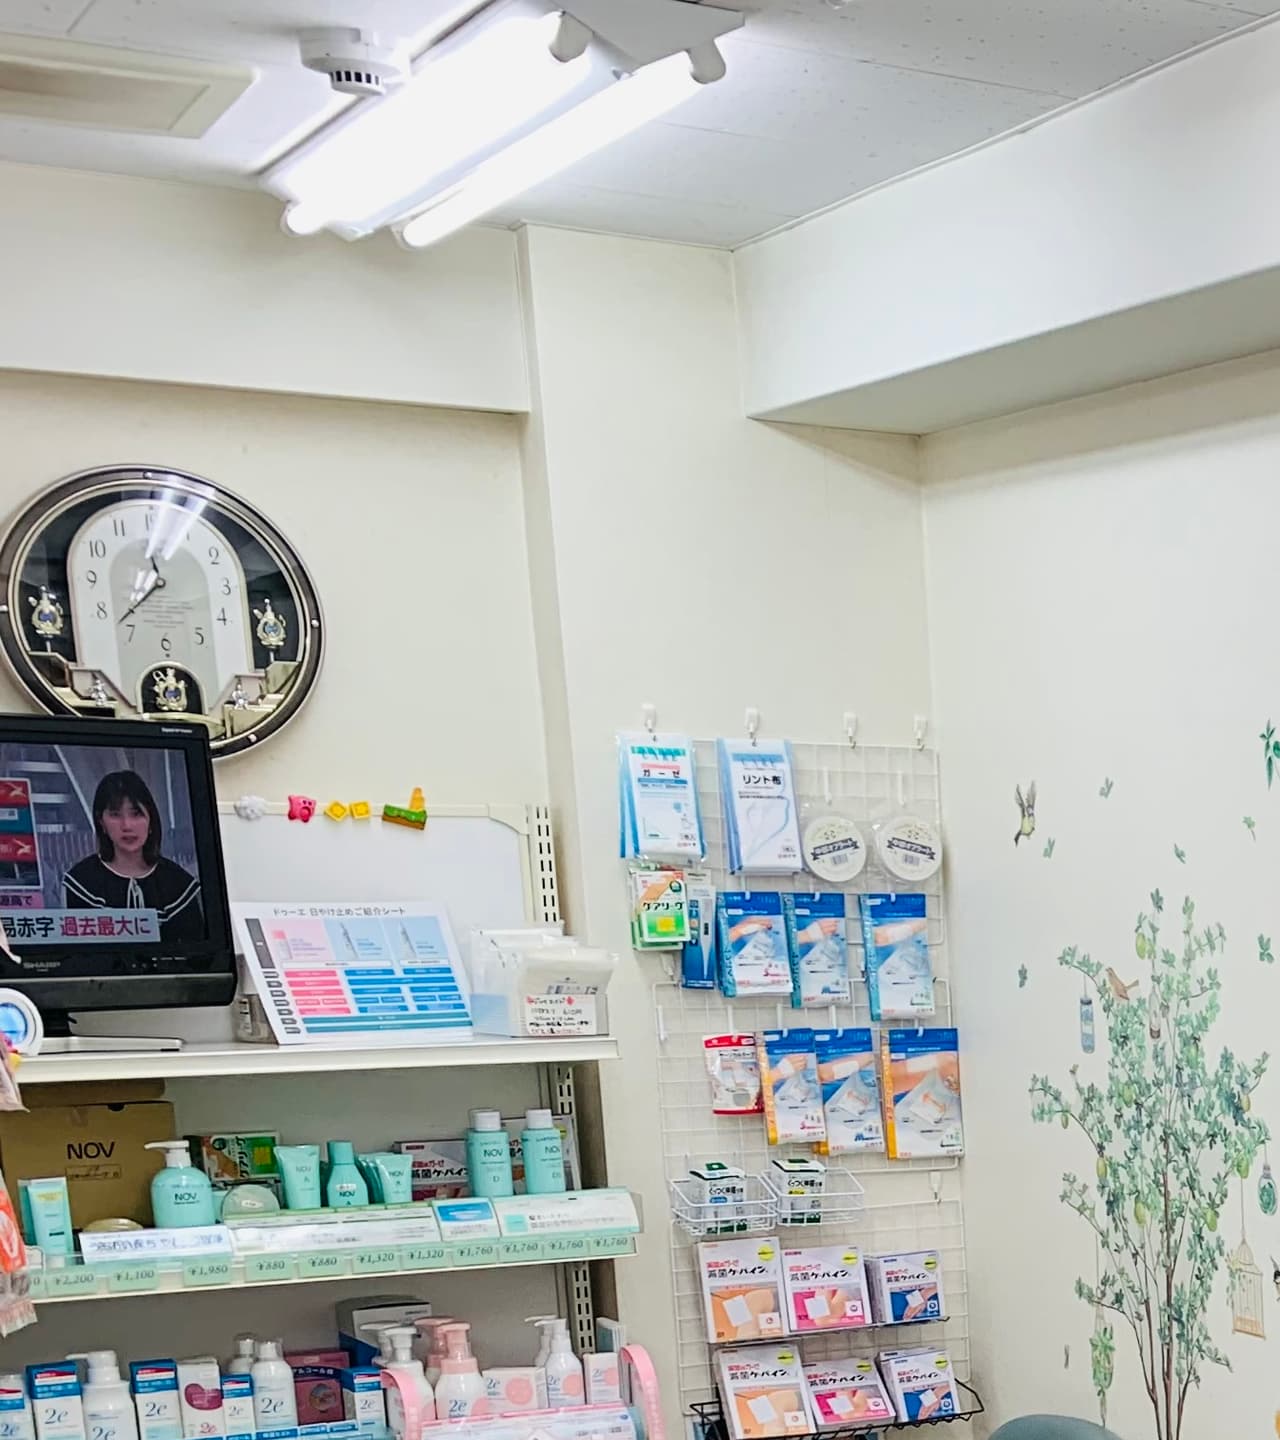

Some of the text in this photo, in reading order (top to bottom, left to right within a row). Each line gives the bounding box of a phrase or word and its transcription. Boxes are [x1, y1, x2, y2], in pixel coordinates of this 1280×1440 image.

[112, 518, 126, 537] 11
[89, 539, 107, 559] 10
[208, 546, 221, 566] 2
[86, 569, 98, 589] 9
[221, 580, 232, 596] 3
[96, 602, 108, 620] 8
[216, 607, 228, 626] 4
[124, 624, 136, 643] 7
[193, 627, 206, 646] 5
[160, 634, 173, 652] 6
[60, 916, 152, 936] 過去最大に
[66, 1142, 115, 1160] NOV
[483, 1149, 502, 1157] NOV
[174, 1192, 198, 1201] NOV
[339, 1190, 355, 1198] NOV
[145, 1402, 167, 1417] 2e
[229, 1405, 243, 1416] 2e
[261, 1398, 285, 1414] 2e
[359, 1399, 375, 1410] 2e
[449, 1400, 466, 1412] 2e
[45, 1408, 68, 1424] 2e
[1, 1423, 20, 1436] 2e
[200, 1423, 216, 1434] 2e
